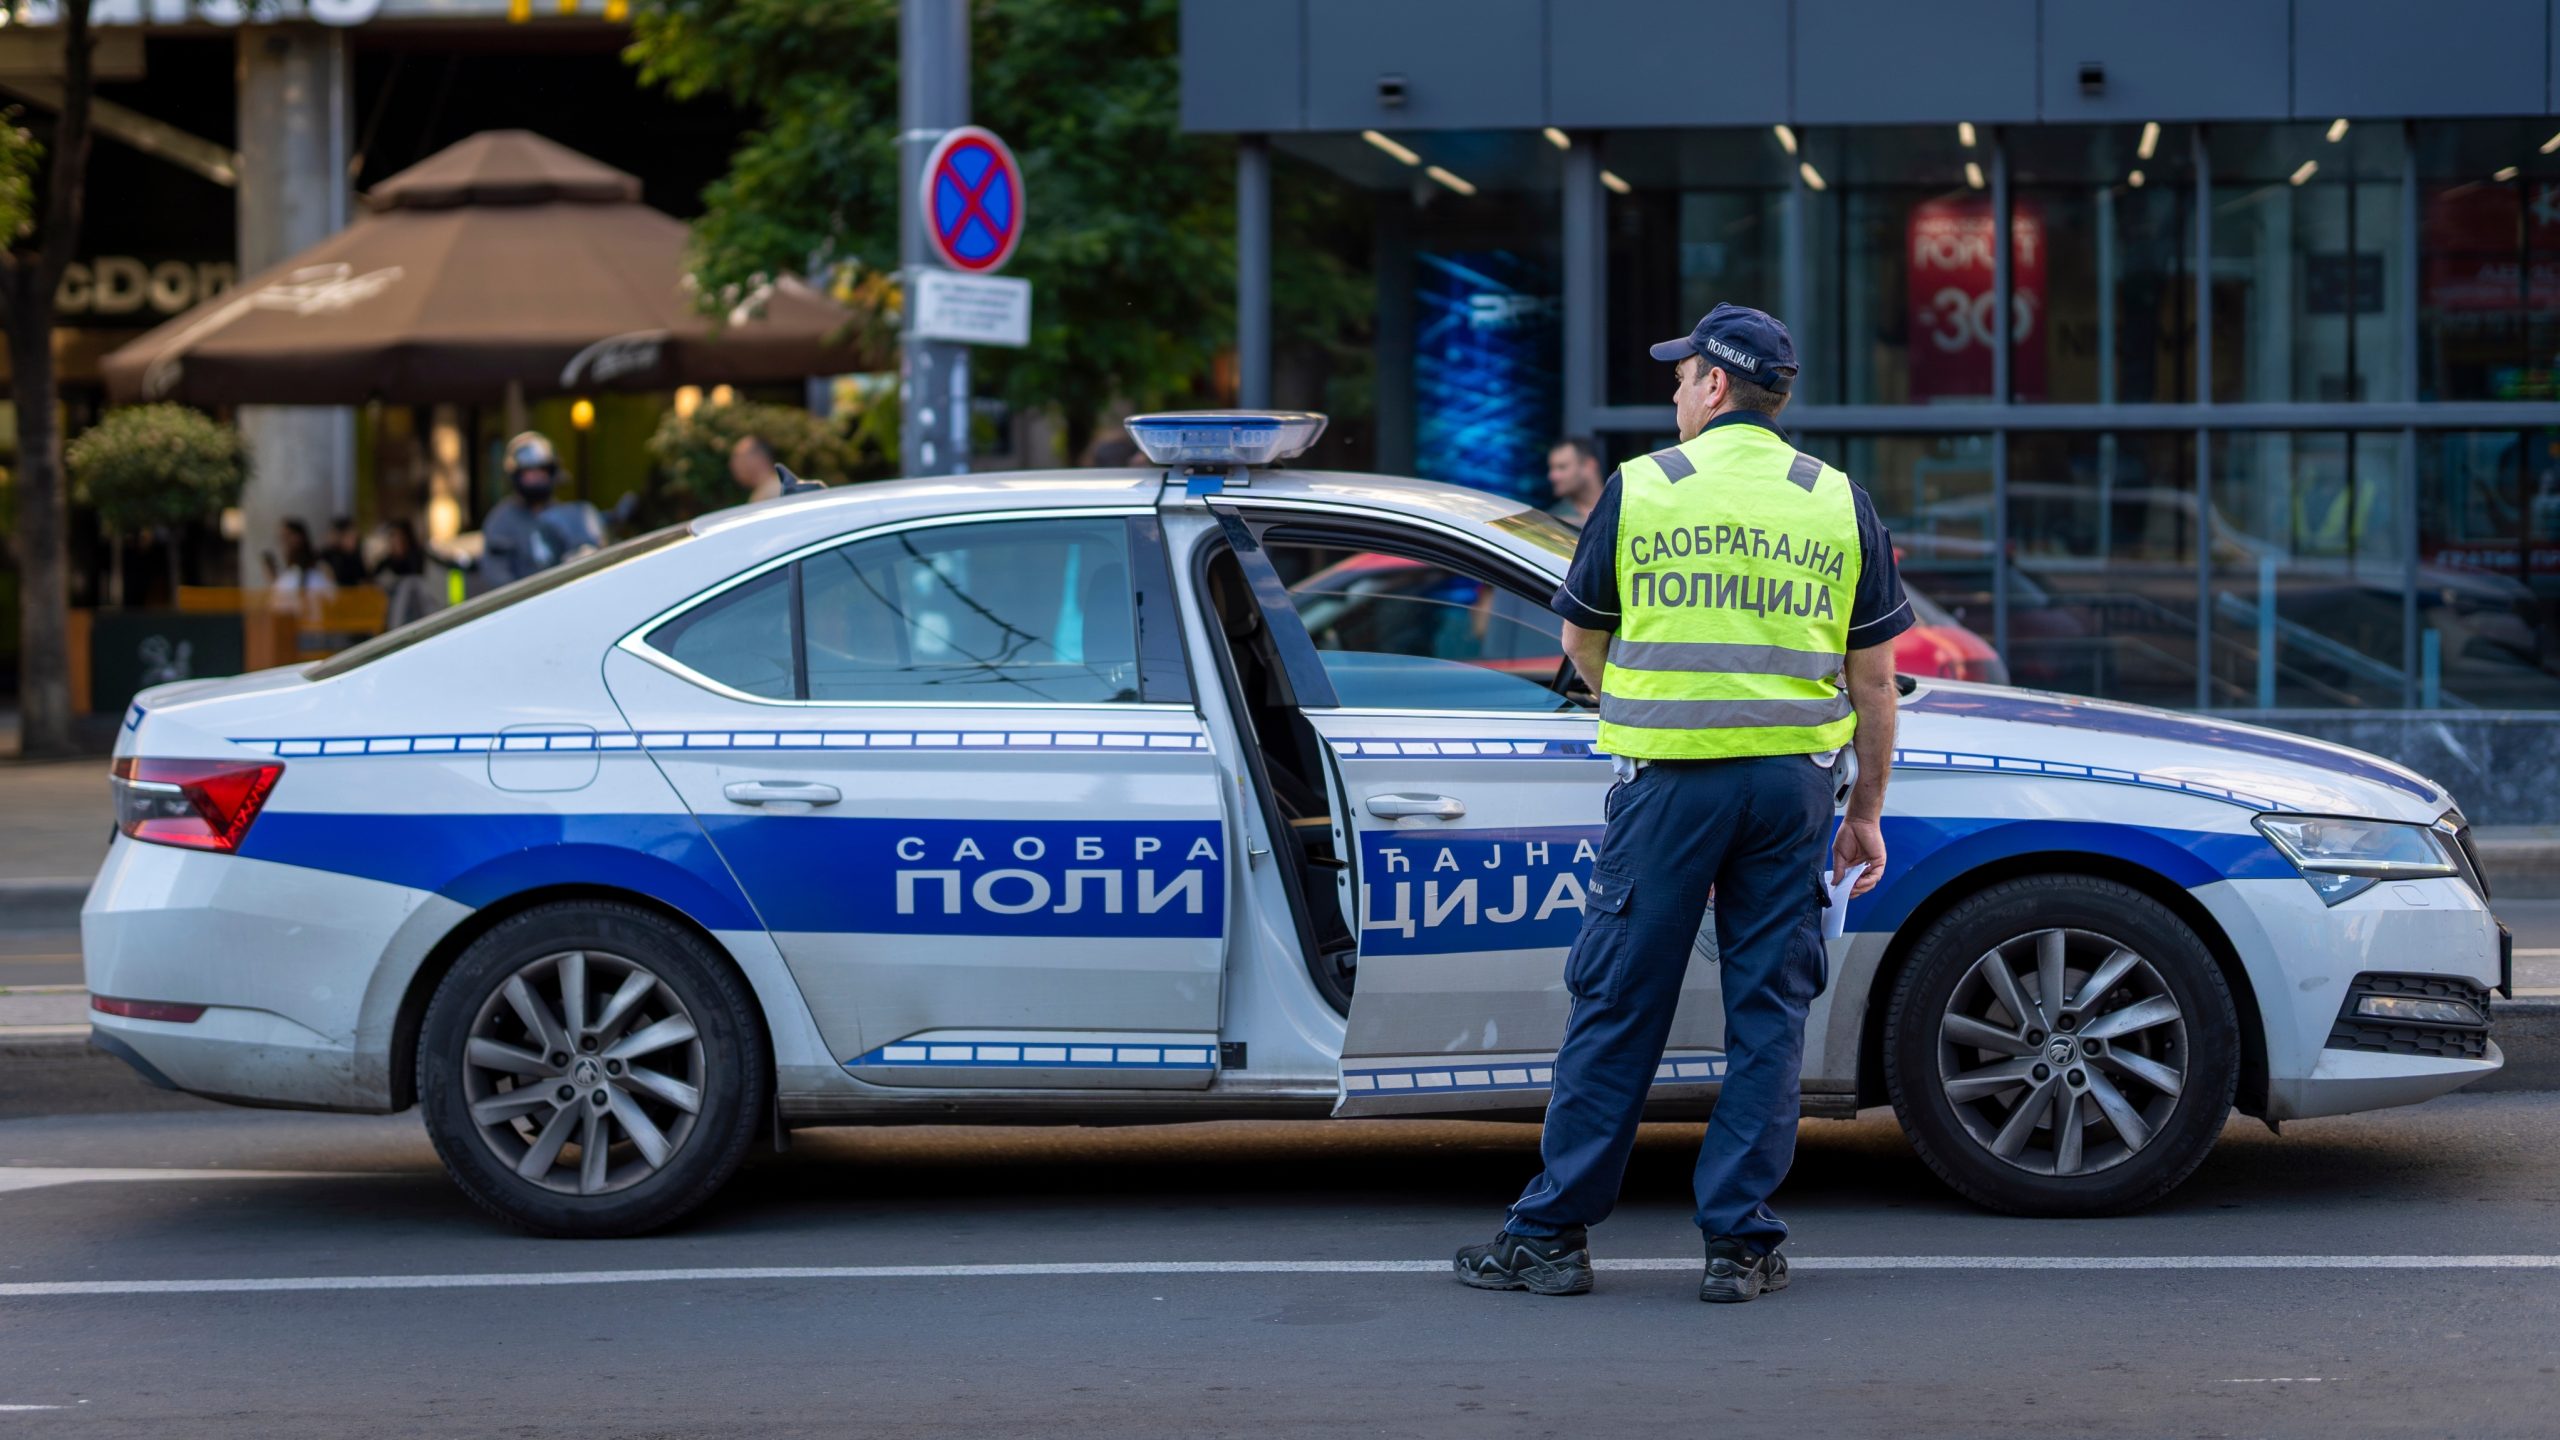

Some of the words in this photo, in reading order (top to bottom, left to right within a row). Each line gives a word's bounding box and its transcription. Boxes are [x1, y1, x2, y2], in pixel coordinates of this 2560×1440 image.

[1707, 338, 1756, 371] ПОЛИЦИЈА
[1631, 525, 1845, 581] САОБРАЋАЈНА
[1631, 571, 1834, 620] ПОЛИЦИЈА
[896, 836, 1219, 862] САОБРА
[1379, 838, 1597, 874] ЋАЈНА
[896, 868, 1204, 915] ПОЛИ
[1362, 872, 1588, 939] ЦИЈА
